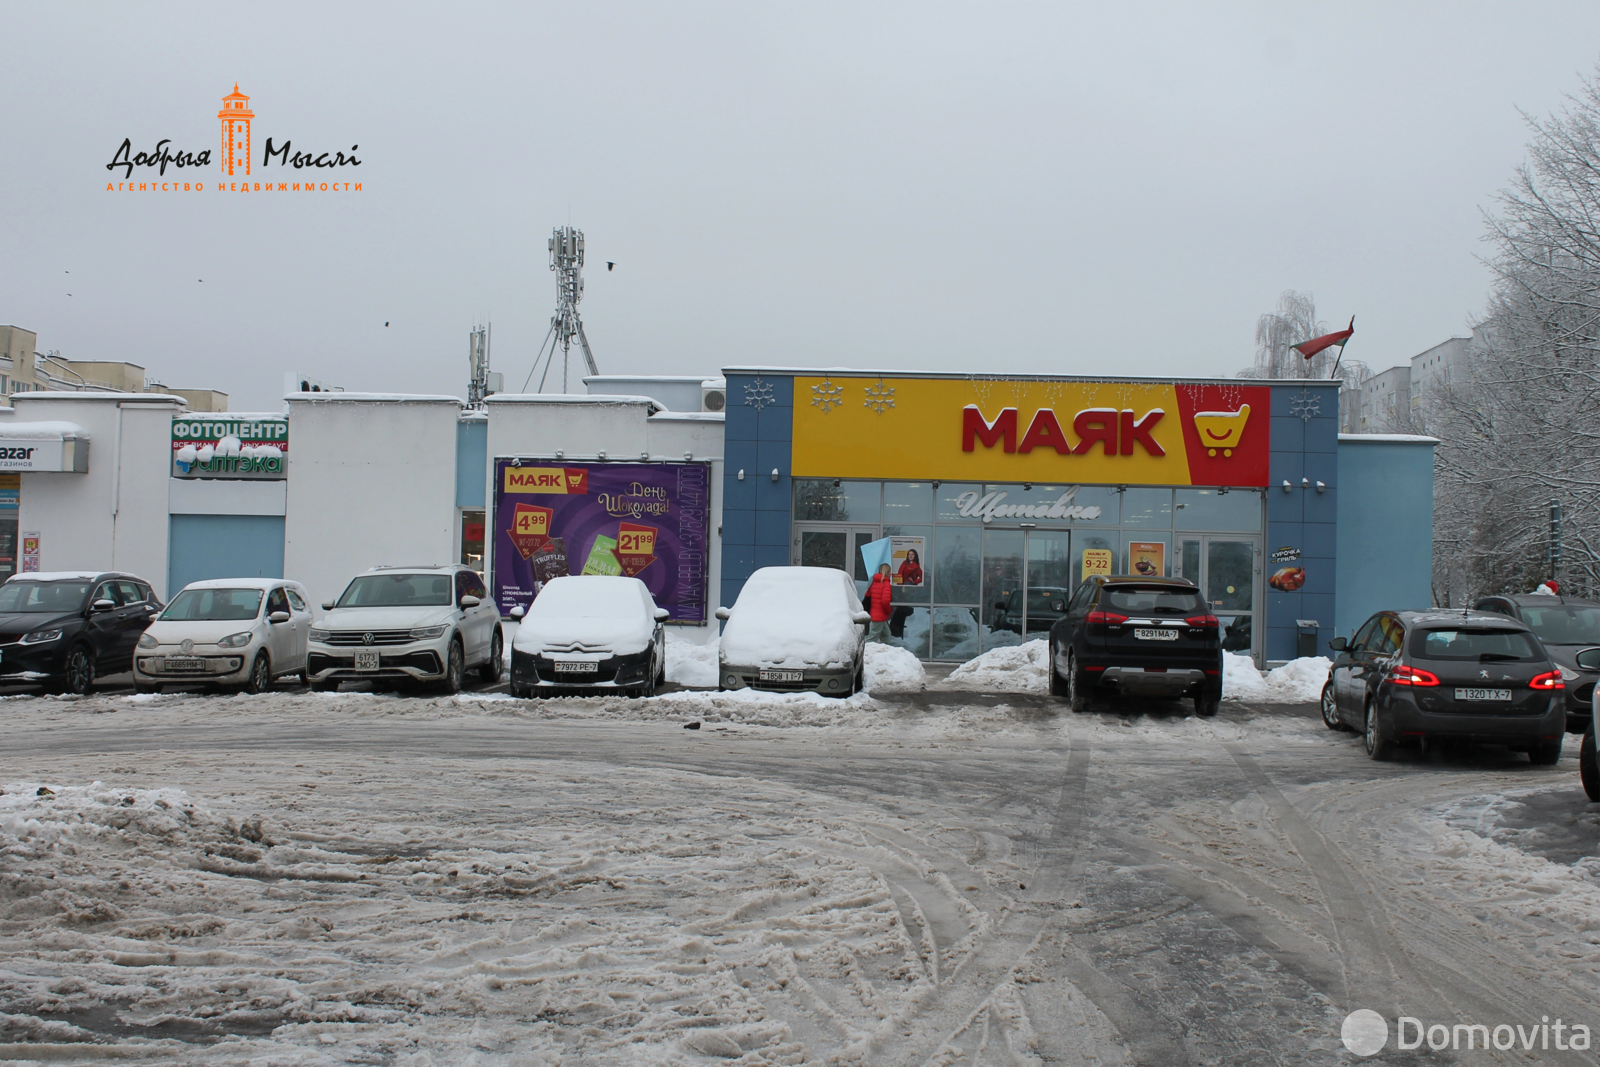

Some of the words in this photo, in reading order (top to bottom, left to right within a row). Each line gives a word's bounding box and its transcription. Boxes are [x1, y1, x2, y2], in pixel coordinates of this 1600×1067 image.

[173, 422, 287, 438] ФОТОЦЕНТР
[962, 405, 1166, 457] МАЯК
[509, 474, 562, 486] МАЯК
[625, 482, 667, 501] День
[598, 493, 670, 518] Шоколада!
[1085, 559, 1108, 569] 9-22
[359, 653, 375, 661] 6173
[561, 663, 578, 671] 7972
[579, 663, 597, 671] PE-7
